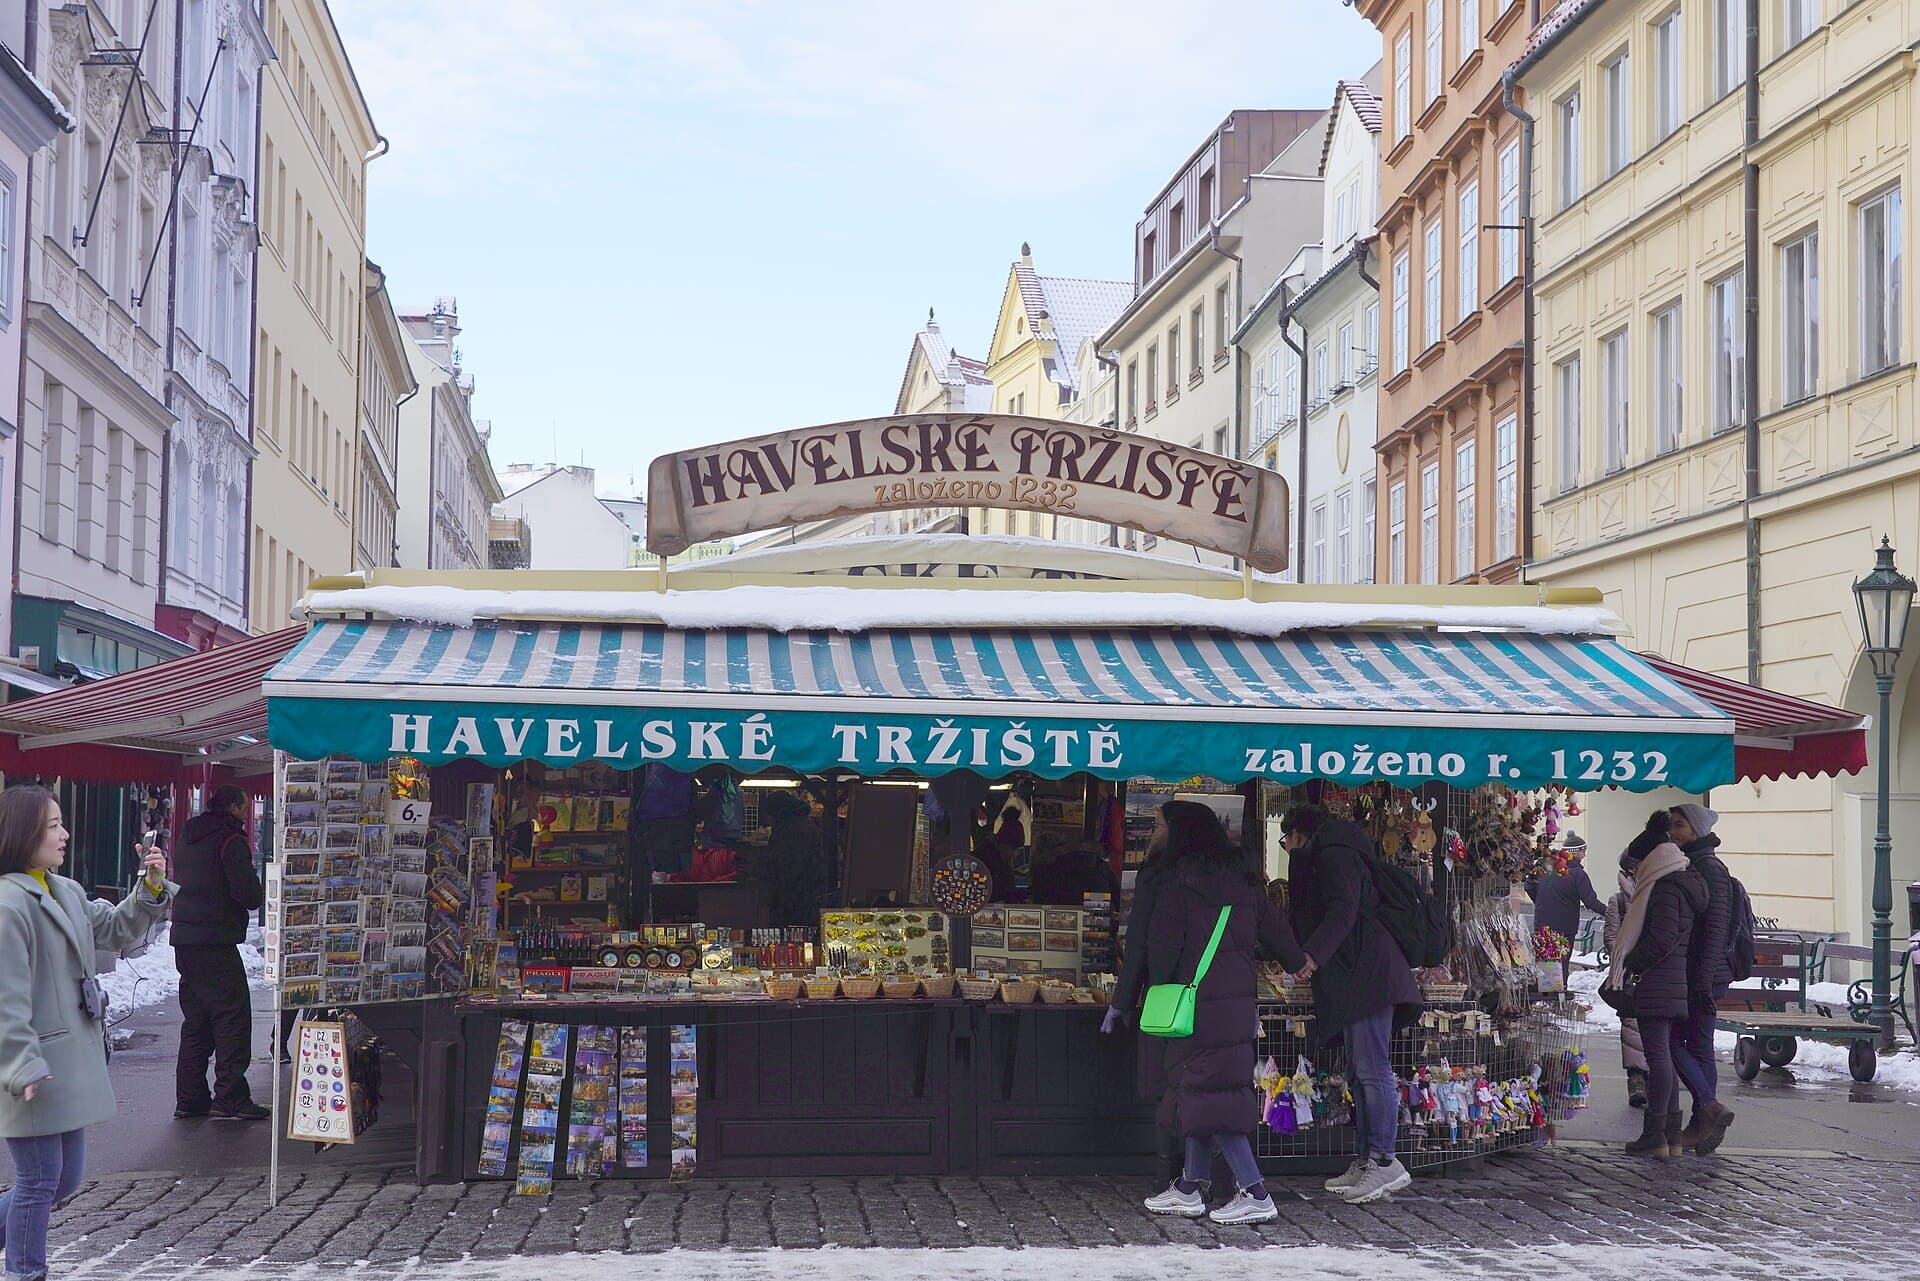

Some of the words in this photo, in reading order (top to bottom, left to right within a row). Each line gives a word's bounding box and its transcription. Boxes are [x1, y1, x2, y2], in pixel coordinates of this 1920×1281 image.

[684, 416, 1000, 507] HAVELSKÉ
[1010, 425, 1252, 523] TRŽIŠTĚ
[874, 477, 1001, 505] založeno
[1009, 476, 1077, 510] 1232
[388, 713, 776, 761] HAVELSKÉ
[832, 718, 1123, 769] TRŽIŠTĚ
[1243, 743, 1466, 777] založeno
[1487, 754, 1521, 779] r.
[1551, 749, 1669, 782] 1232
[317, 1032, 325, 1041] CZ
[303, 1096, 311, 1105] CZ
[318, 1119, 328, 1130] CZ
